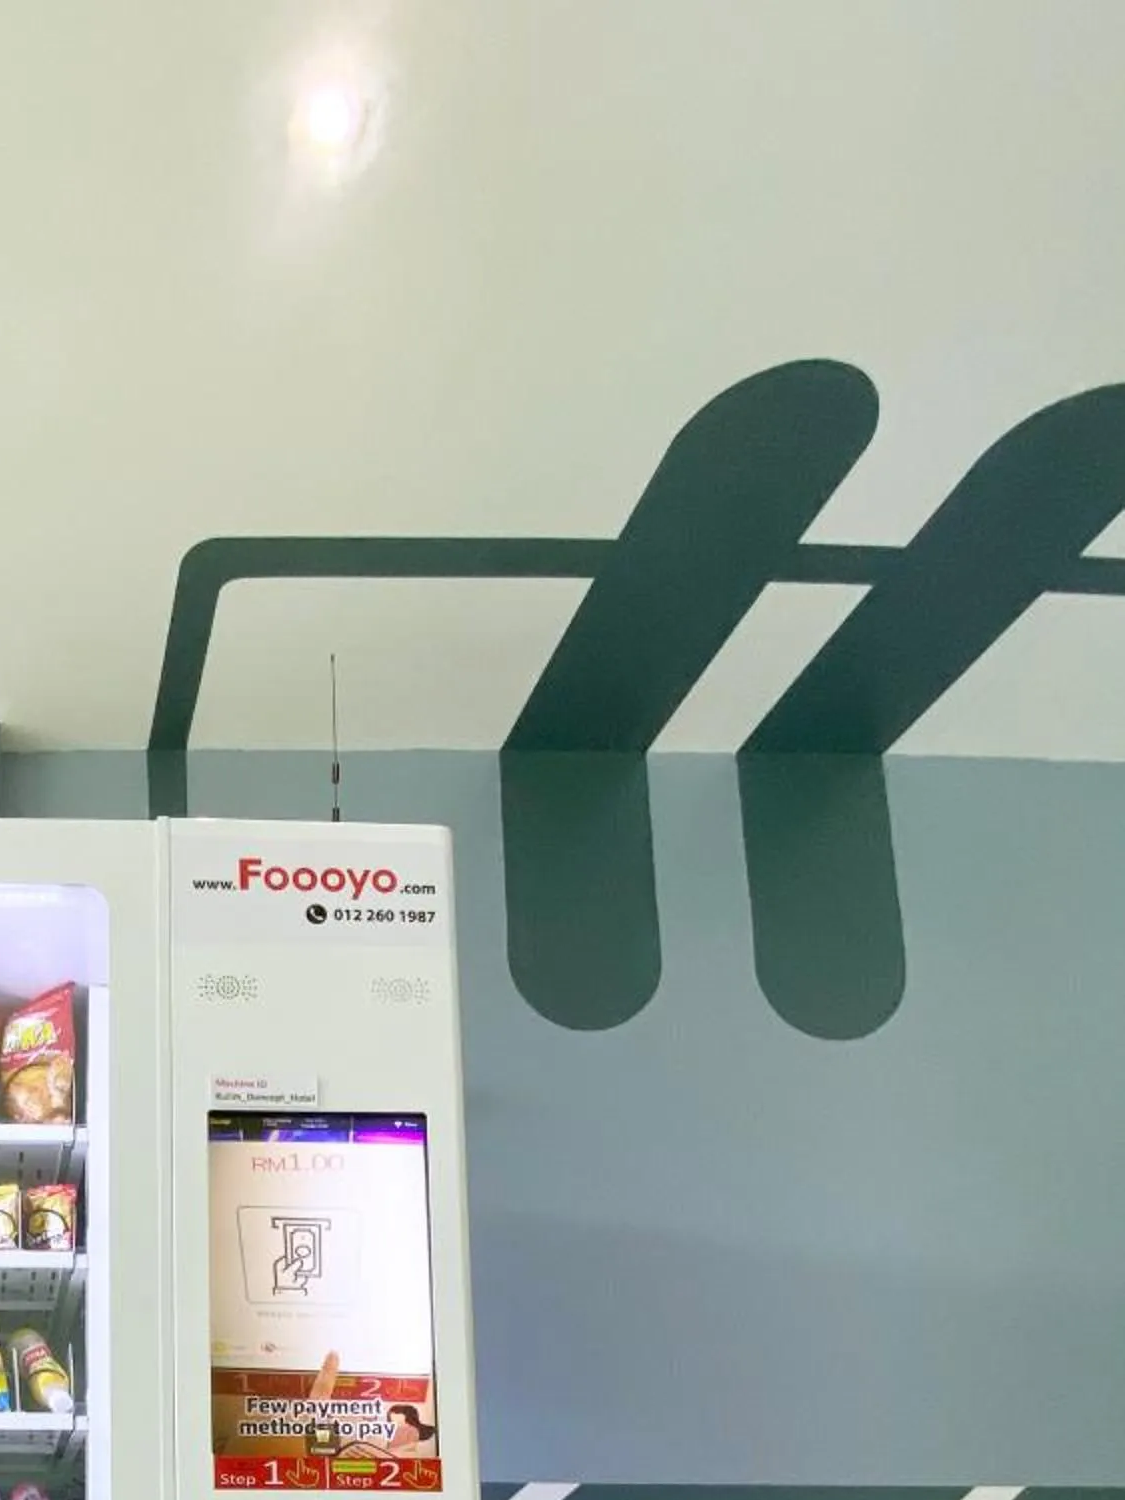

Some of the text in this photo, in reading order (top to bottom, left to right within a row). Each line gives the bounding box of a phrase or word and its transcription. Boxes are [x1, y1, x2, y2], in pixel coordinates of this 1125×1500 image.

[192, 858, 436, 900] www.Foooyo.com
[334, 909, 436, 923] 012 260 1987
[247, 1398, 382, 1417] Few payment
[334, 1420, 353, 1434] to
[359, 1423, 395, 1438] pay
[220, 1461, 284, 1486] Step 1
[336, 1462, 402, 1487] Step 2
